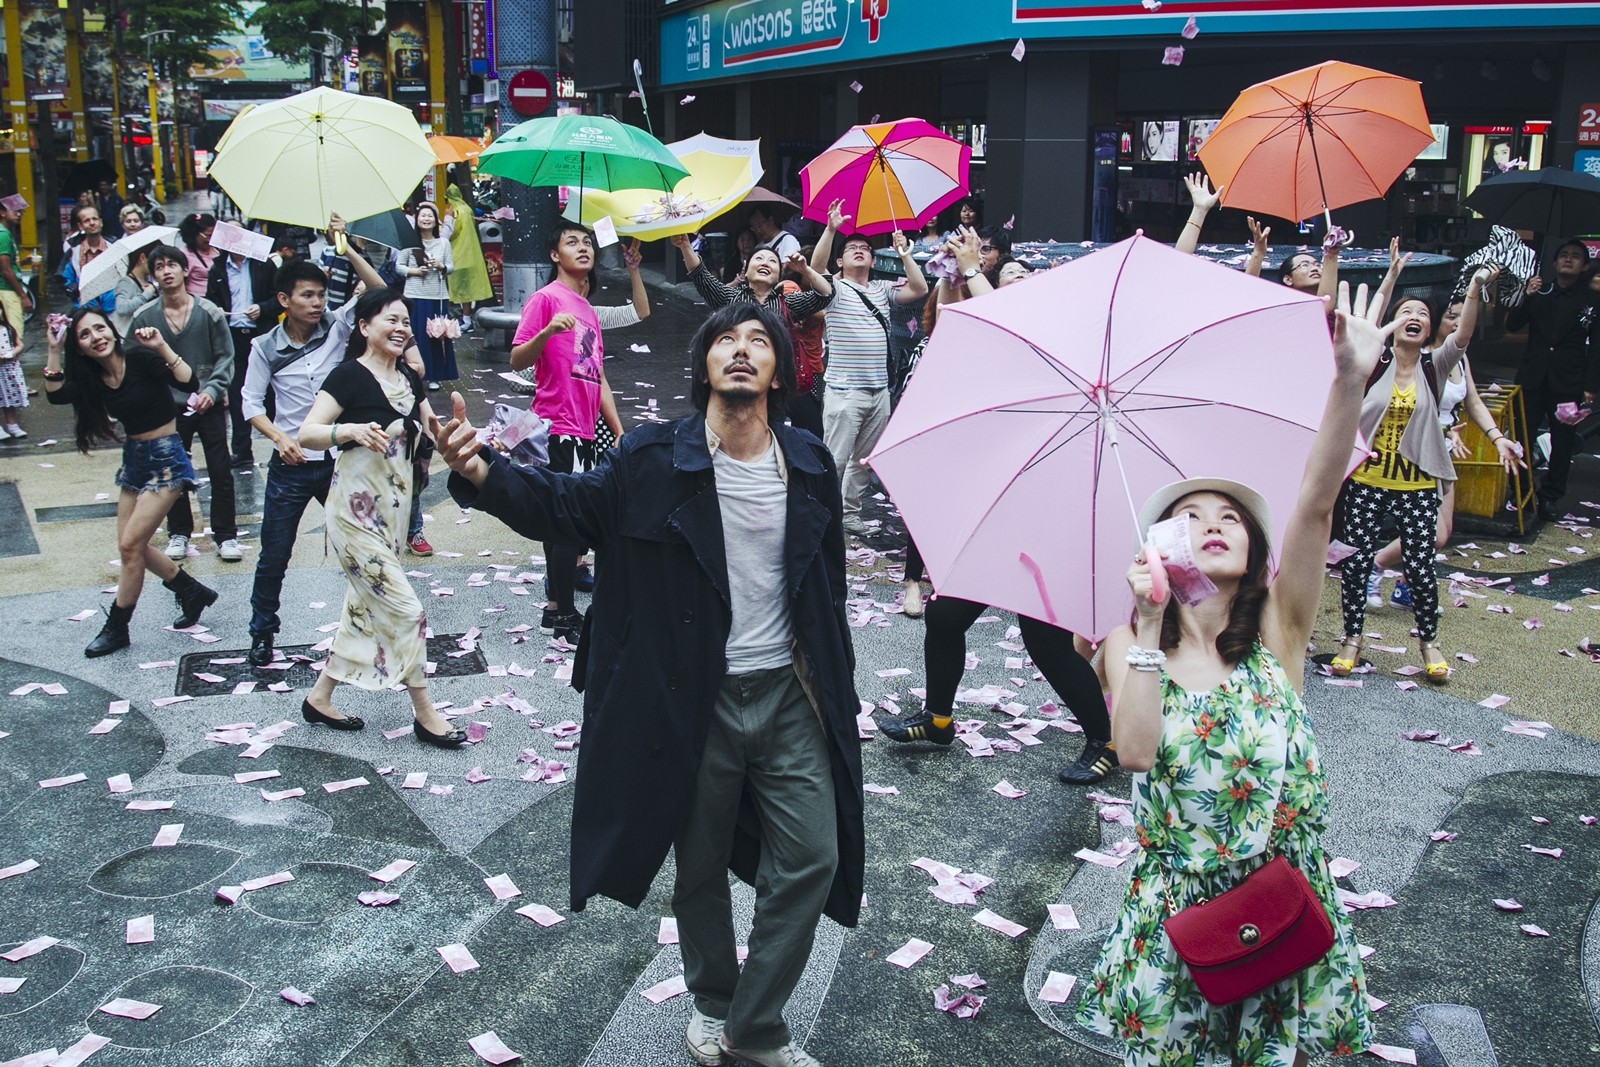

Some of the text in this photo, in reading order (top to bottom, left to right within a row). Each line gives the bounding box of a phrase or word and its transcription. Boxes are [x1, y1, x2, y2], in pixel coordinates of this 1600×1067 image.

[731, 8, 792, 48] watsons
[801, 0, 837, 35] 屈臣氏
[15, 114, 24, 124] H
[1581, 108, 1600, 127] 2
[14, 132, 29, 141] 12
